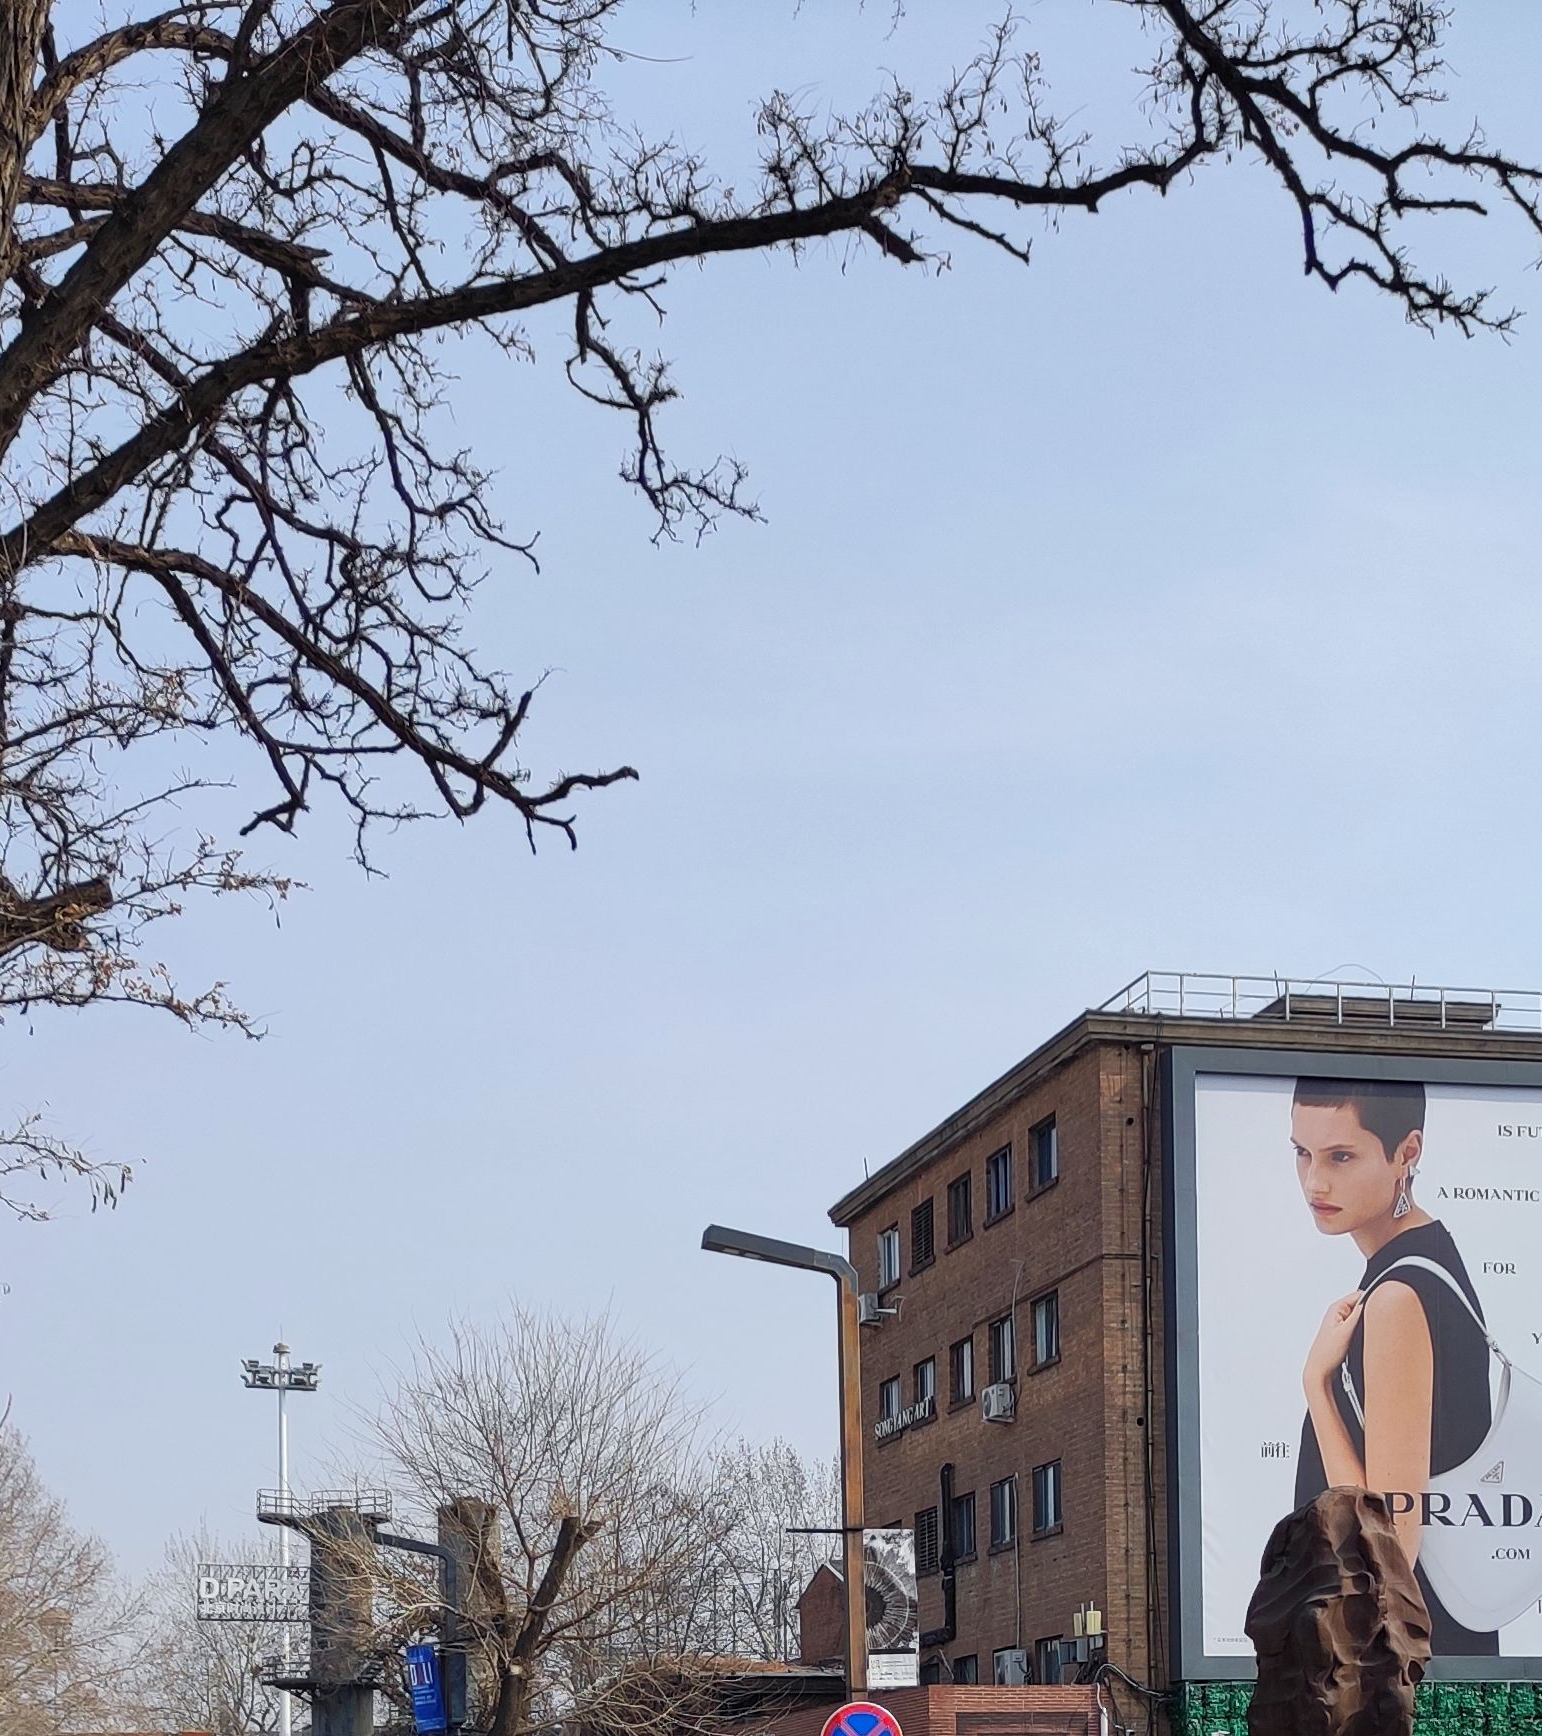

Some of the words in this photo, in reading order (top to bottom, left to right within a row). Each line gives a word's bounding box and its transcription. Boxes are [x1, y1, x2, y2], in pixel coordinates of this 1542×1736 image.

[1497, 1124, 1513, 1138] IS
[1436, 1186, 1449, 1199] A
[1453, 1187, 1540, 1202] ROMANTIC
[1483, 1261, 1517, 1275] FOR
[1260, 1440, 1290, 1459] 前往
[1491, 1547, 1531, 1561] .COM
[199, 1577, 220, 1600] D
